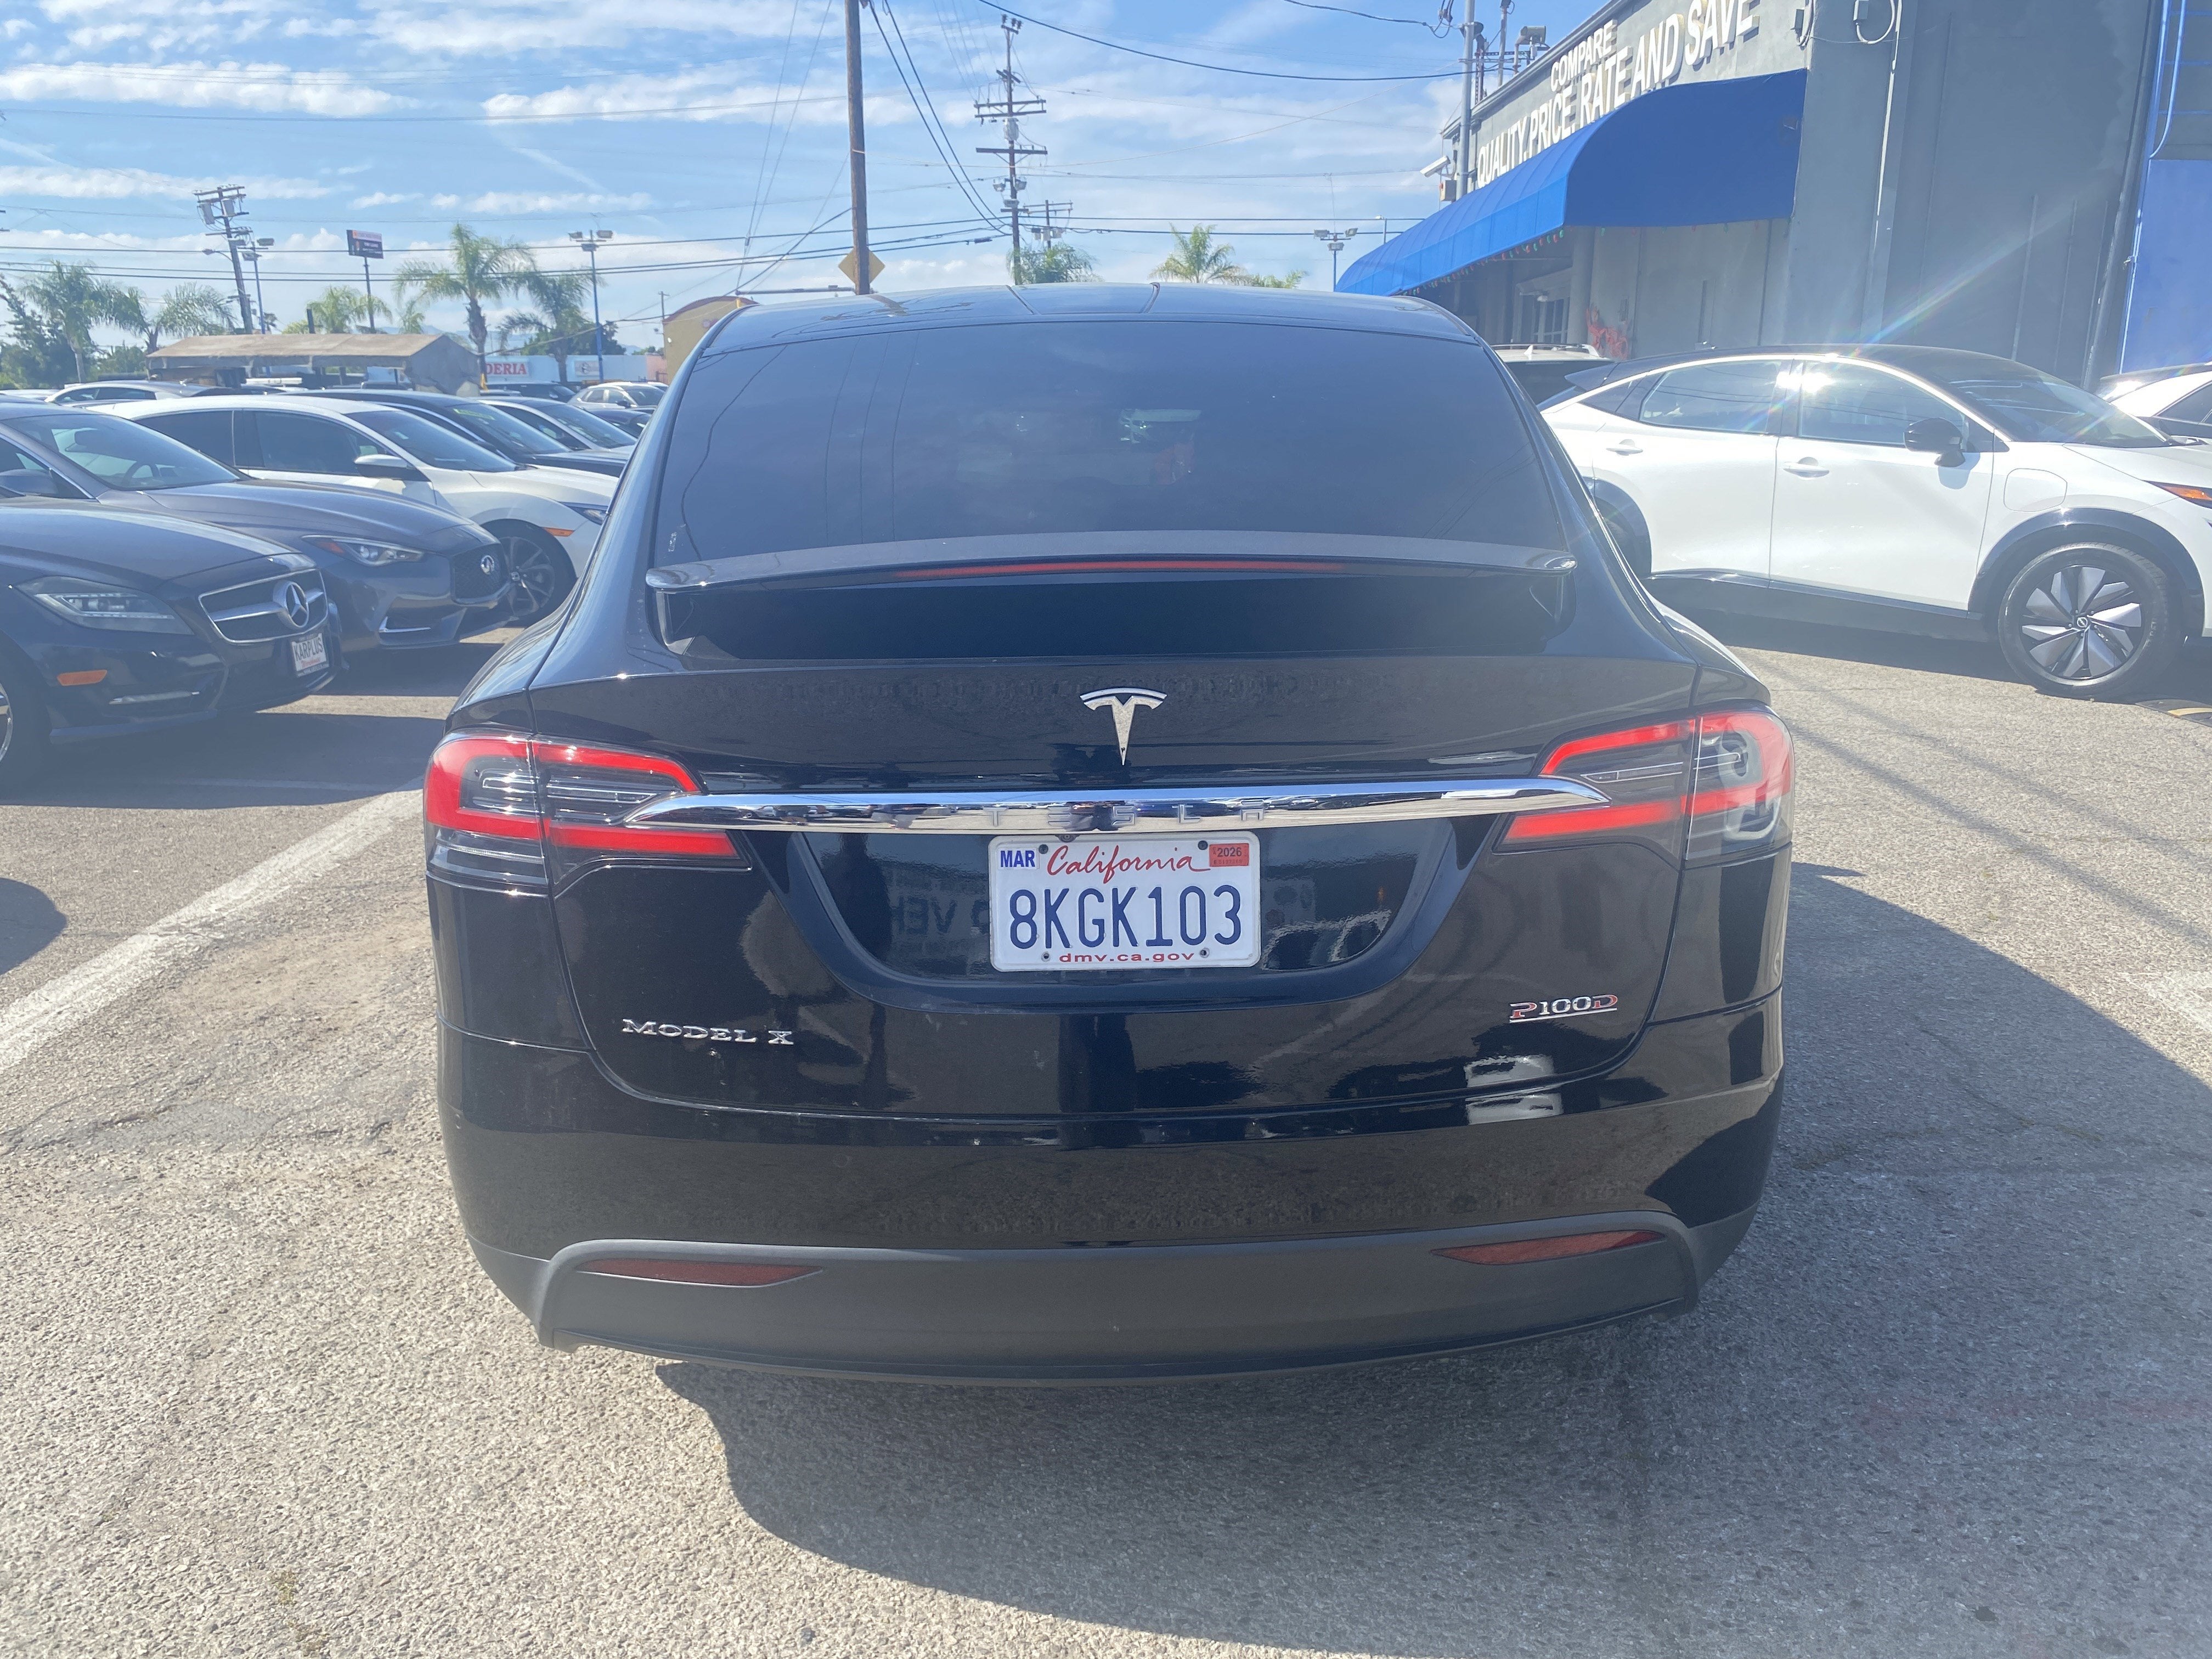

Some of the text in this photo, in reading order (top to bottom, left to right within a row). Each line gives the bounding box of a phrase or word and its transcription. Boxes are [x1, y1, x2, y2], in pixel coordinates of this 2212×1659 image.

[1550, 19, 1613, 92] COMPARE
[1580, 46, 1628, 128] RATE
[1630, 13, 1679, 99] AND
[293, 637, 324, 662] KARPLUS
[1000, 850, 1035, 868] MAR
[1047, 845, 1211, 884] California
[1217, 847, 1242, 857] 2026
[1009, 884, 1241, 949] 8KGK103
[1059, 951, 1195, 963] dmv.ca.gov
[1510, 994, 1618, 1019] P100D
[622, 1019, 794, 1045] MODEL X
